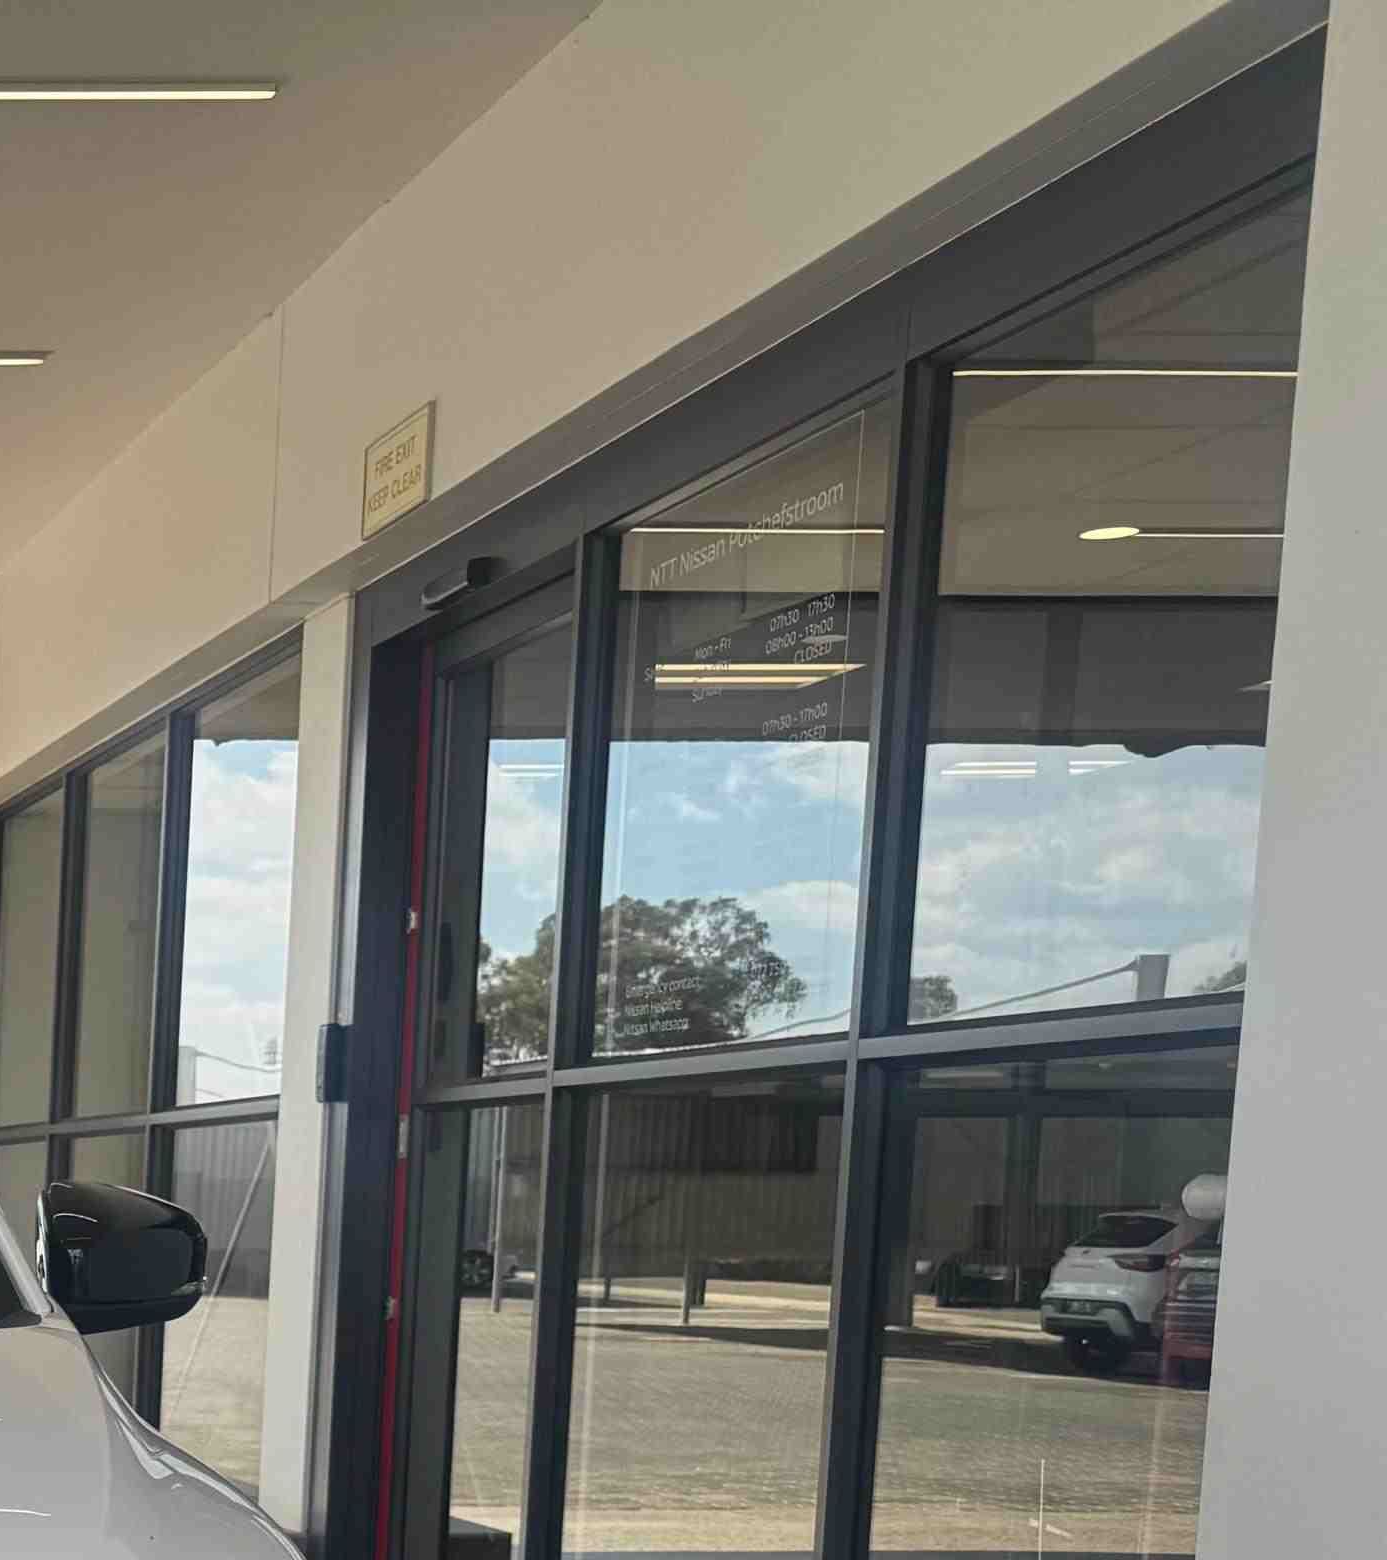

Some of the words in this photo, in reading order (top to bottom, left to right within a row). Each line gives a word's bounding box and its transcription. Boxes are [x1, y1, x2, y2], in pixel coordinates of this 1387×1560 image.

[391, 463, 422, 499] CLEAR
[650, 556, 677, 589] NTT
[680, 537, 726, 577] Nissan
[729, 482, 844, 552] Potchefstroom
[770, 608, 800, 633] 07h30
[807, 593, 835, 617] 17h30
[765, 631, 796, 655] 08h00
[794, 639, 832, 665] CLOSED
